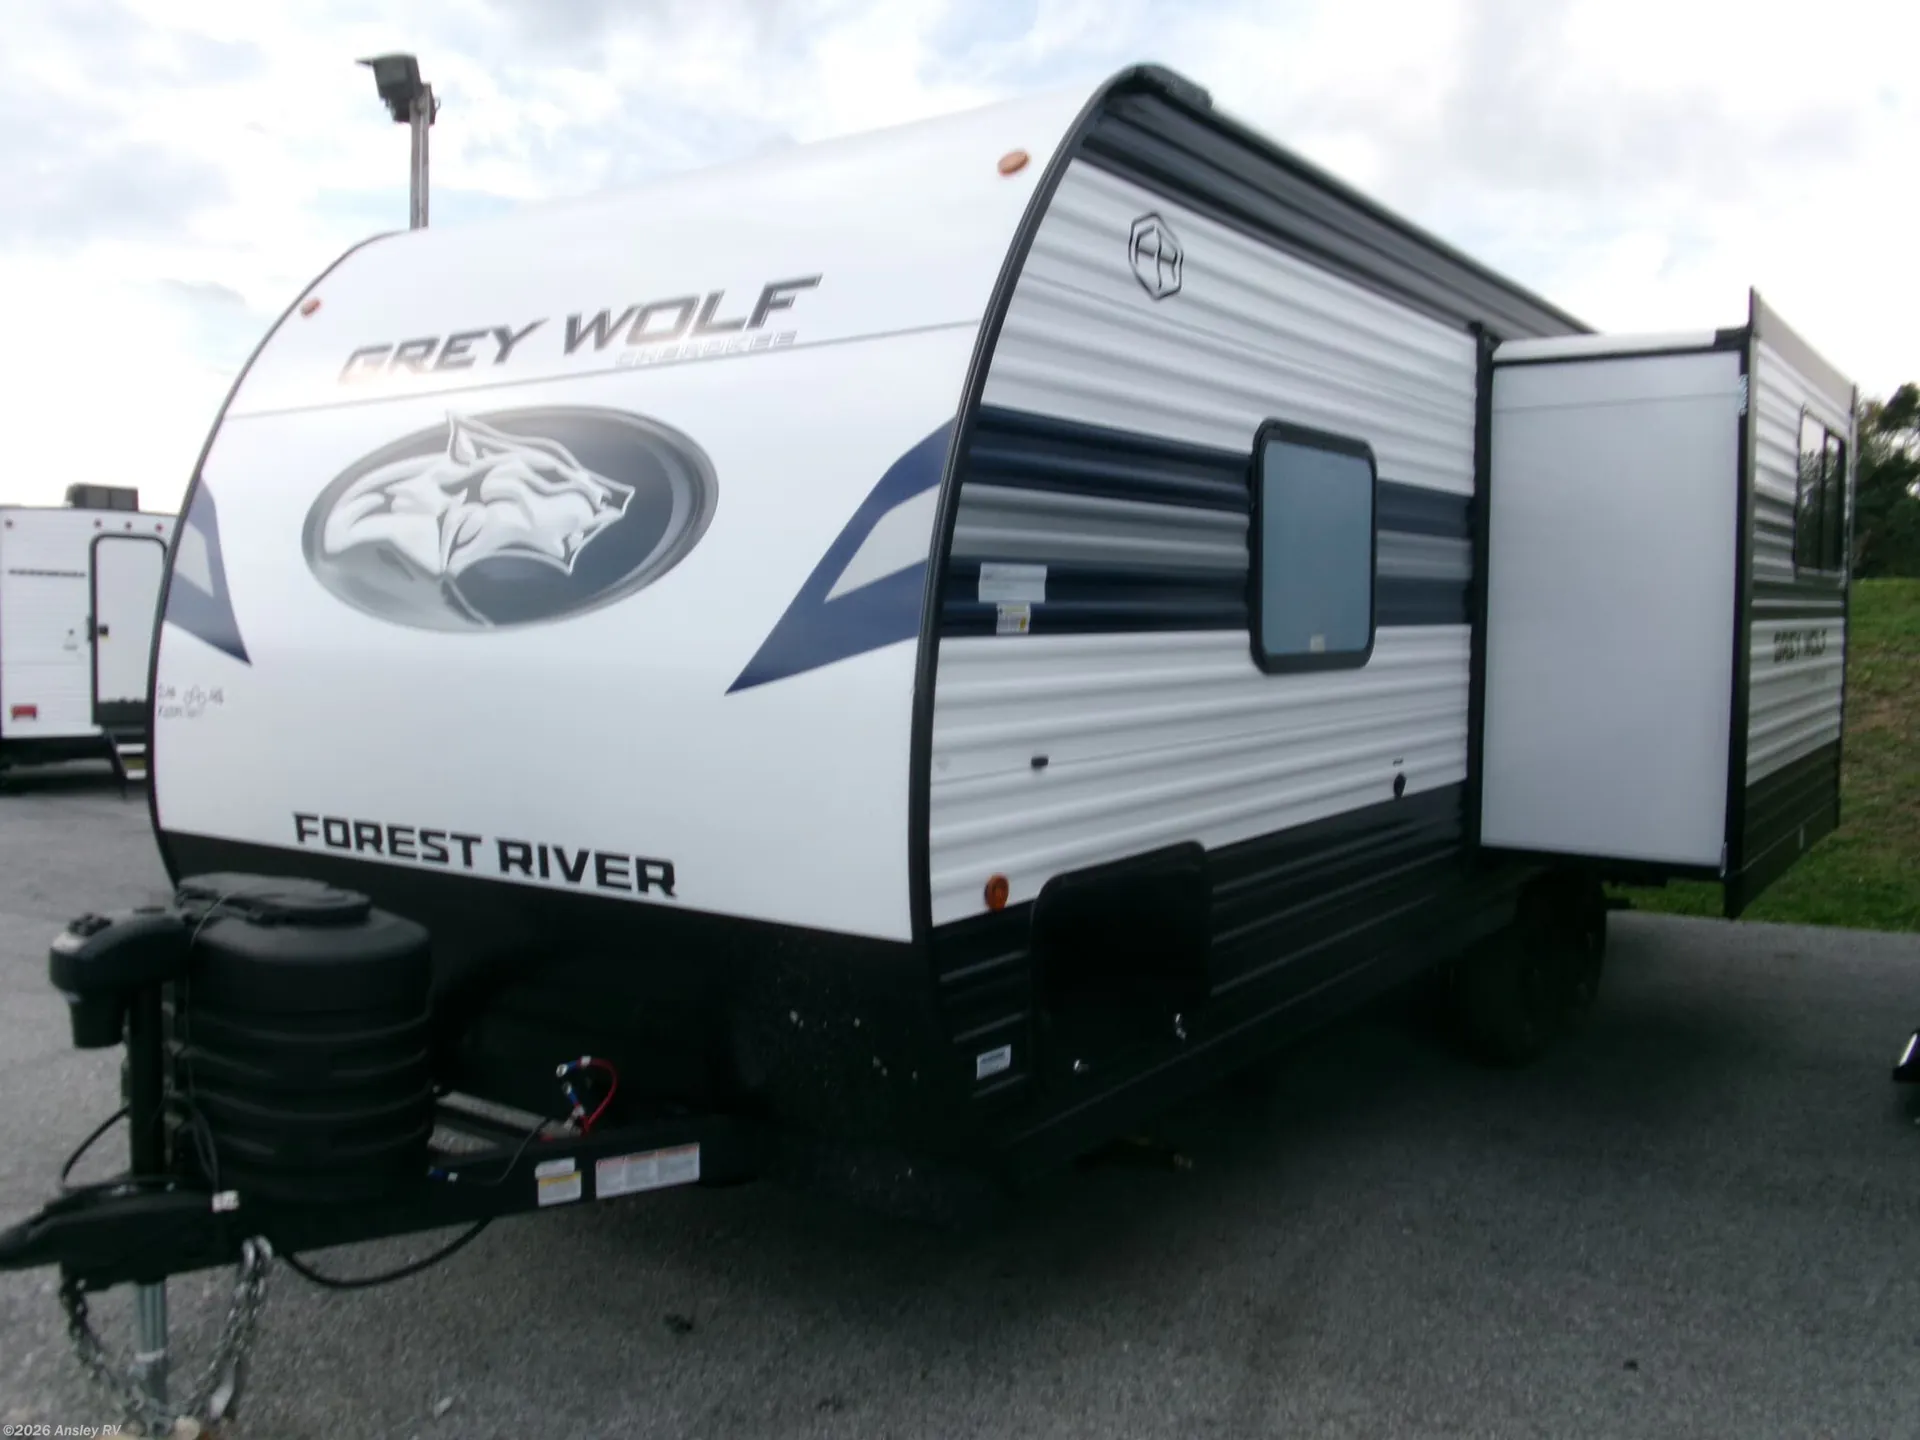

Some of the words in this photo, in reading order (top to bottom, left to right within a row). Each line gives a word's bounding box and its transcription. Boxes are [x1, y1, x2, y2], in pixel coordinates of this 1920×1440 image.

[338, 317, 550, 384] GREY
[563, 272, 824, 356] WOLF
[292, 811, 483, 869] FOREST
[495, 836, 678, 898] RIVER
